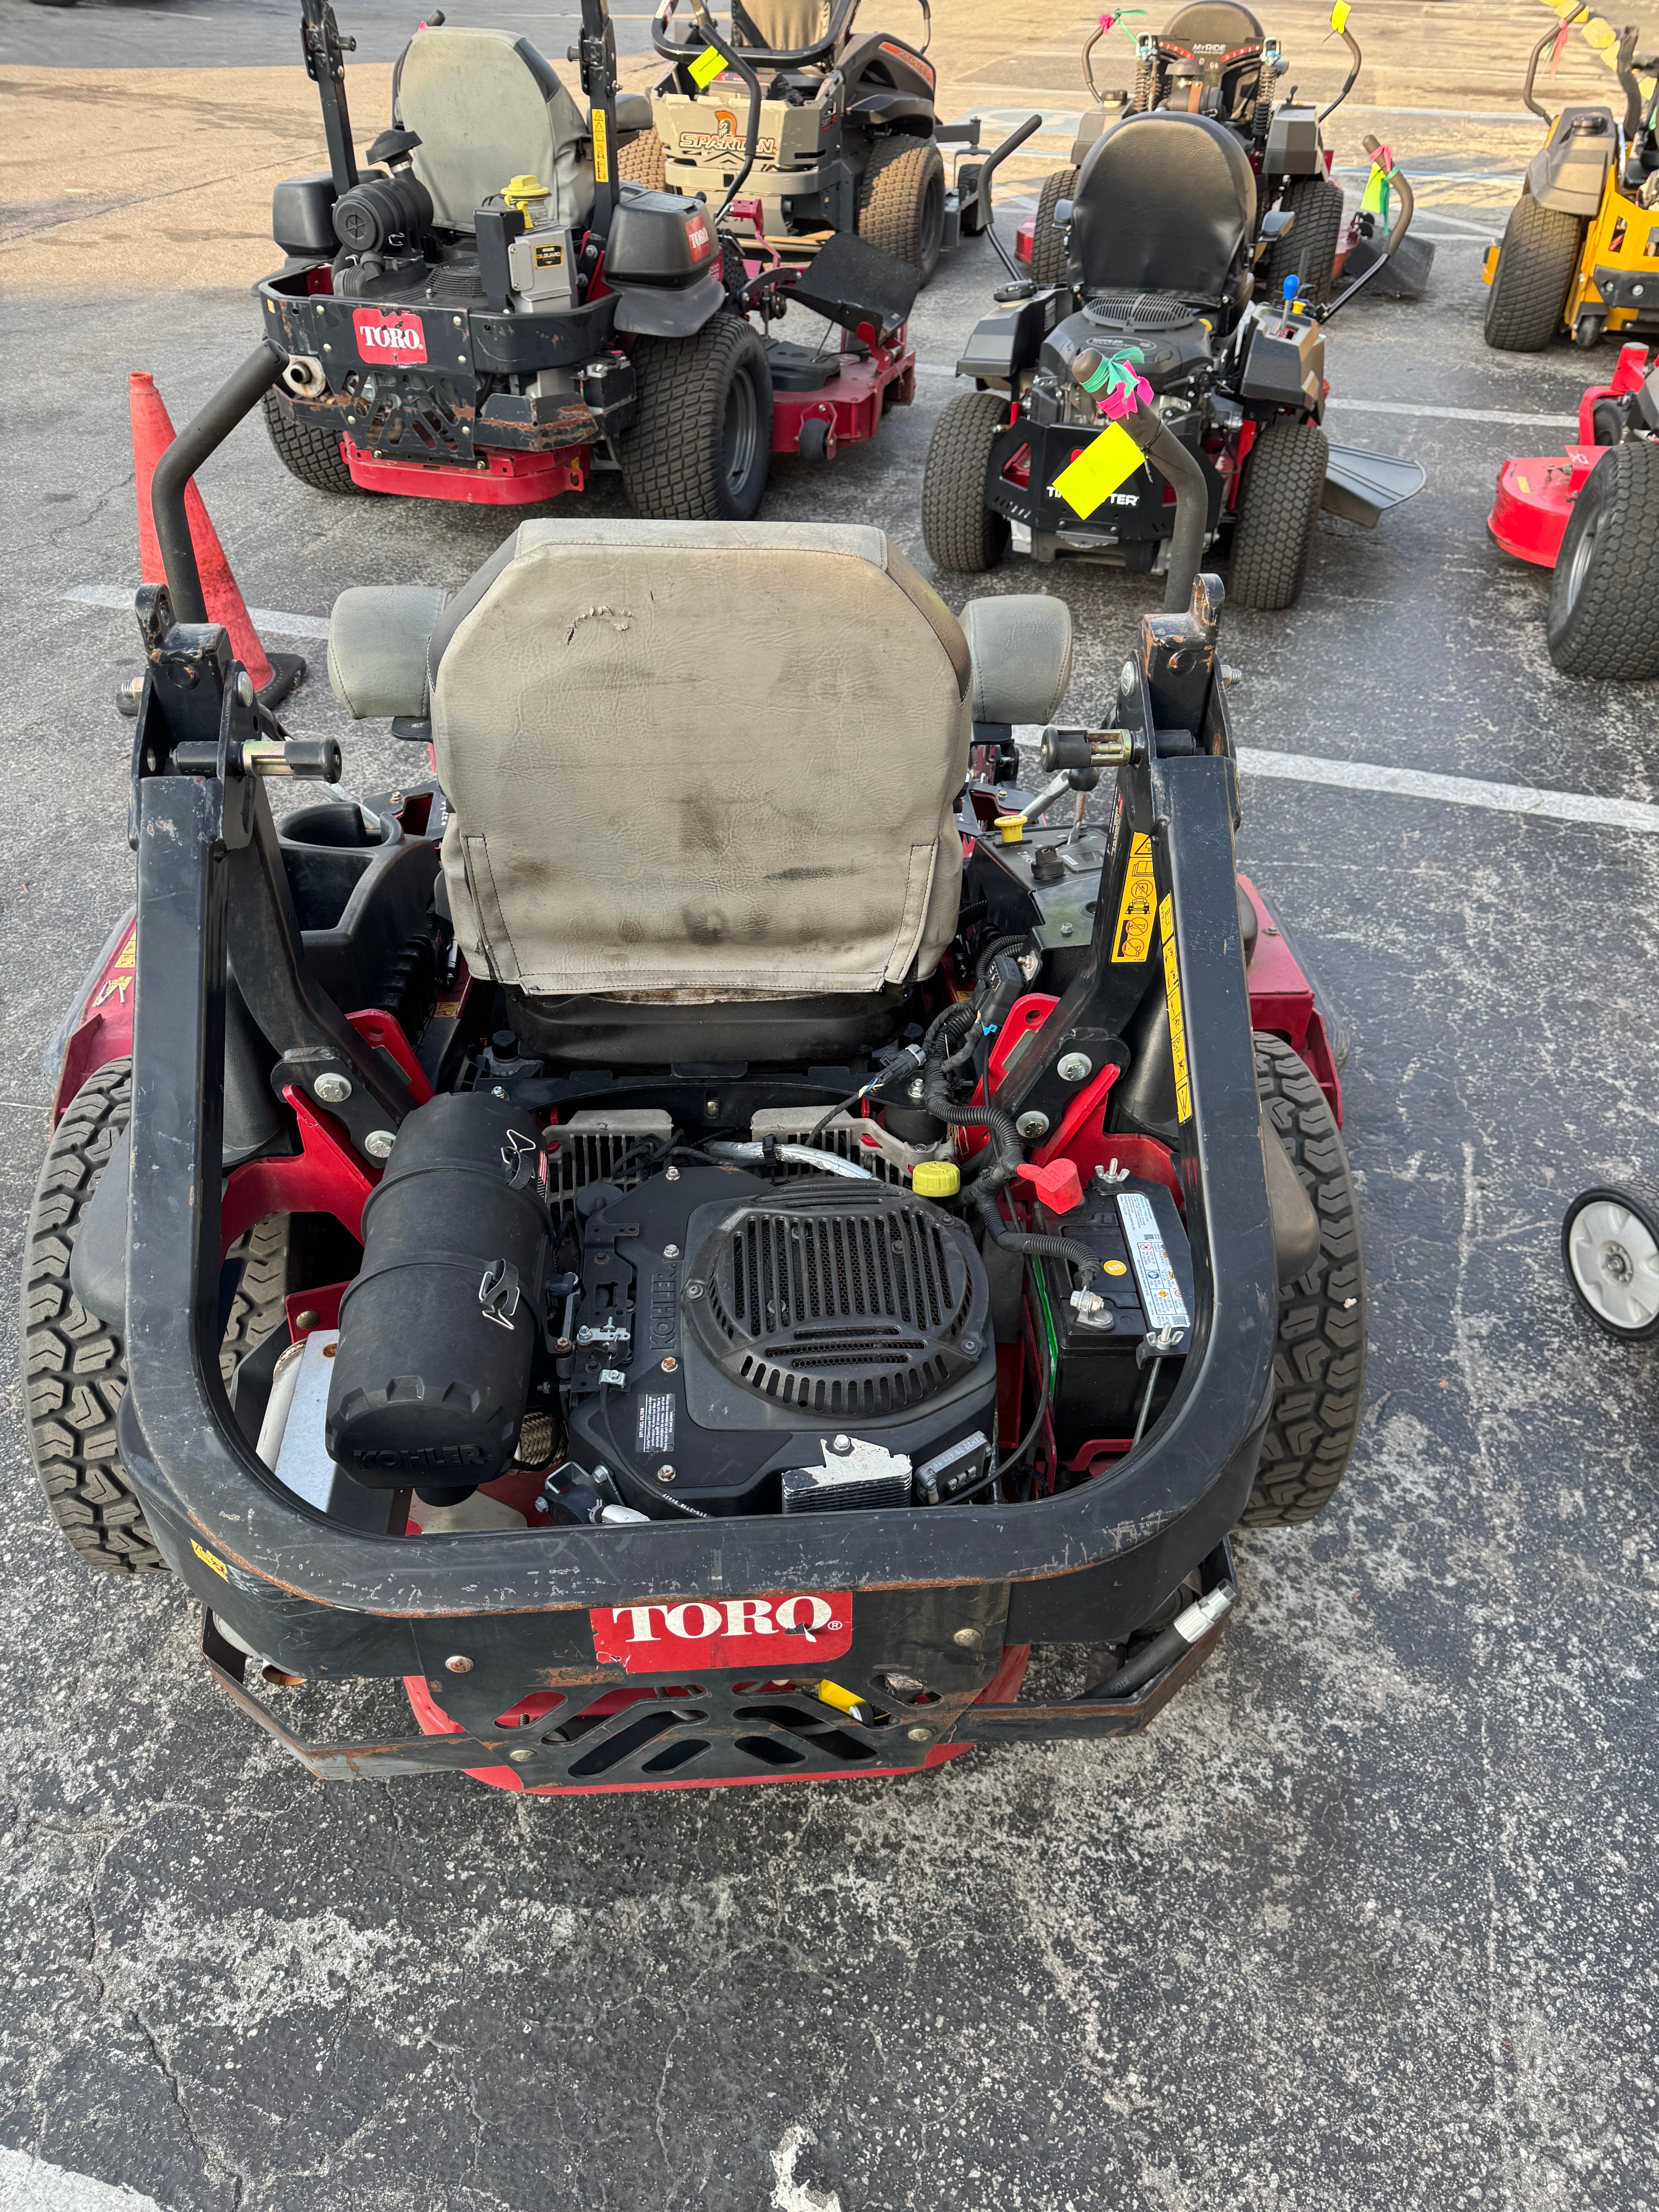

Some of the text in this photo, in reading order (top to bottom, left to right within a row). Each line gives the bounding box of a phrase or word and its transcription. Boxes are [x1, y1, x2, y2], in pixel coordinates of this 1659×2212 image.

[679, 133, 775, 153] SPARTN
[359, 326, 420, 349] TORO
[650, 1268, 676, 1350] KOHLER
[353, 1444, 485, 1471] KOHLER
